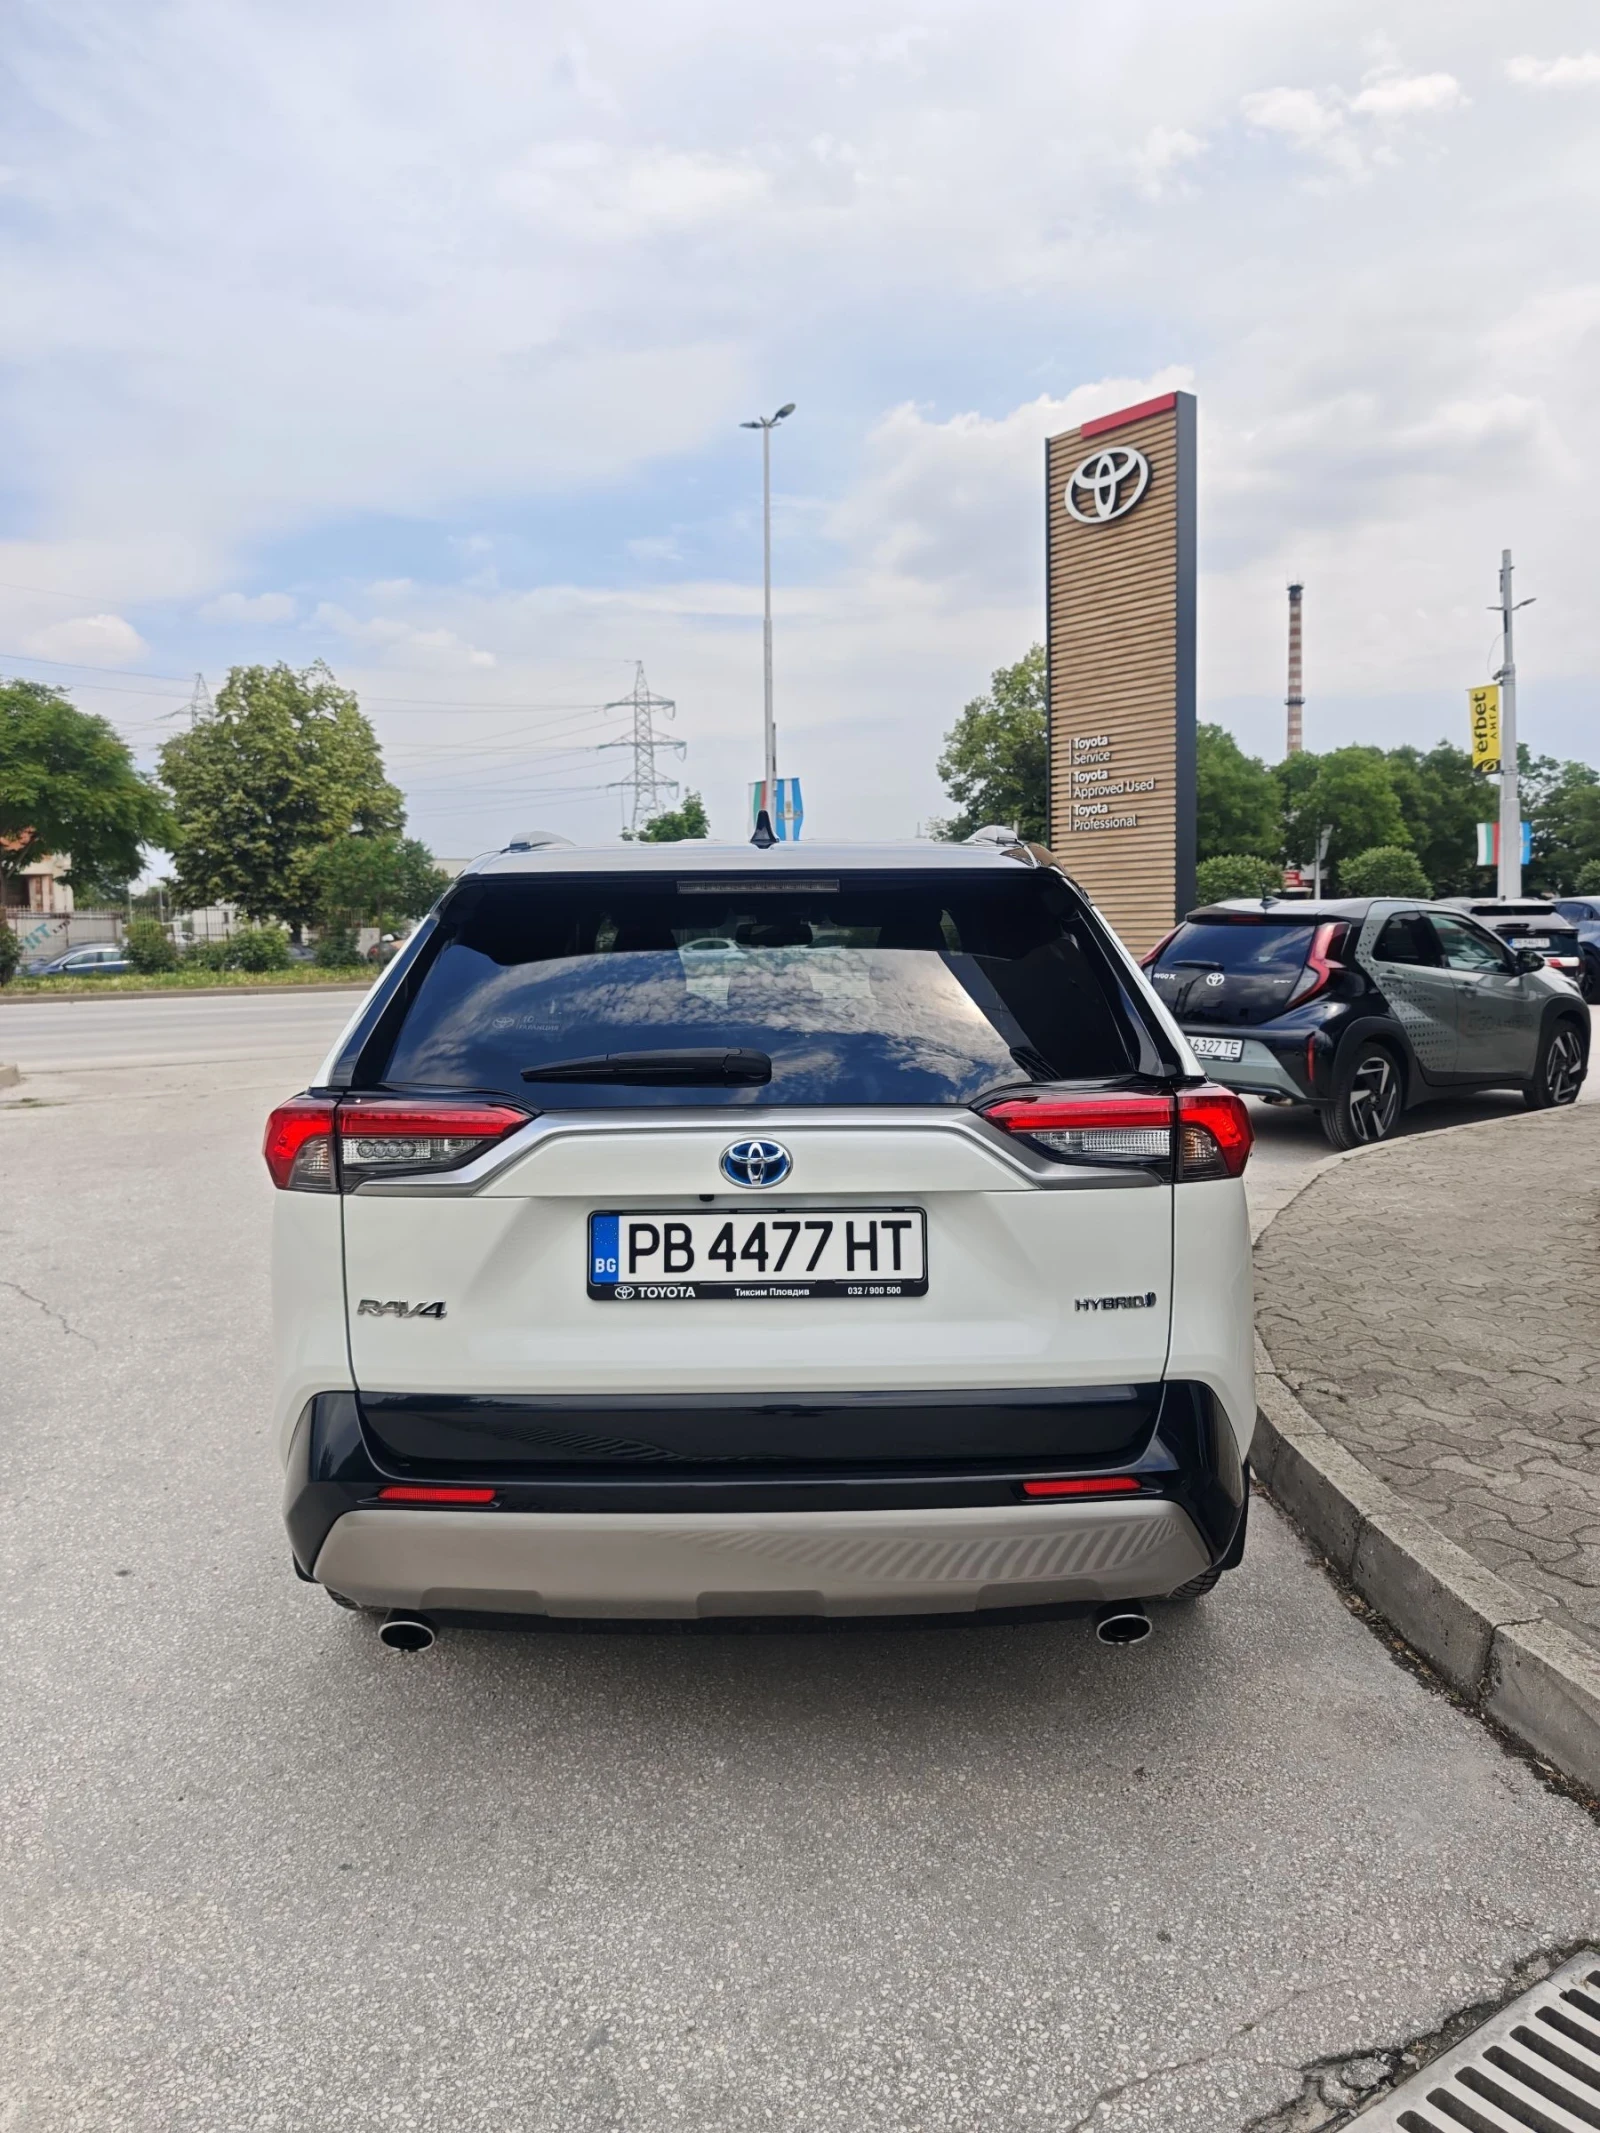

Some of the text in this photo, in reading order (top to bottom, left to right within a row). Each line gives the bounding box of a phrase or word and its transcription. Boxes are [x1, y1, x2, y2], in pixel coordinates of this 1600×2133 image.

[1473, 692, 1487, 753] efbet
[1073, 735, 1109, 751] Toyota
[1073, 750, 1111, 765] Service
[1073, 769, 1109, 784] Toyota
[1073, 777, 1155, 799] Approved Used
[1073, 803, 1109, 818] Toyota
[1073, 814, 1137, 831] Professional
[1193, 1038, 1222, 1053] 6327
[1224, 1041, 1239, 1055] TE
[628, 1219, 912, 1274] PB 4477 HT
[595, 1258, 617, 1273] BG
[638, 1286, 696, 1299] TOYOTA
[734, 1287, 810, 1298] Тиксим Пловдив
[847, 1286, 862, 1295] 032
[869, 1286, 885, 1295] 900
[886, 1286, 902, 1295] 500
[357, 1299, 447, 1320] RAV4
[1075, 1295, 1145, 1311] HYBRID
